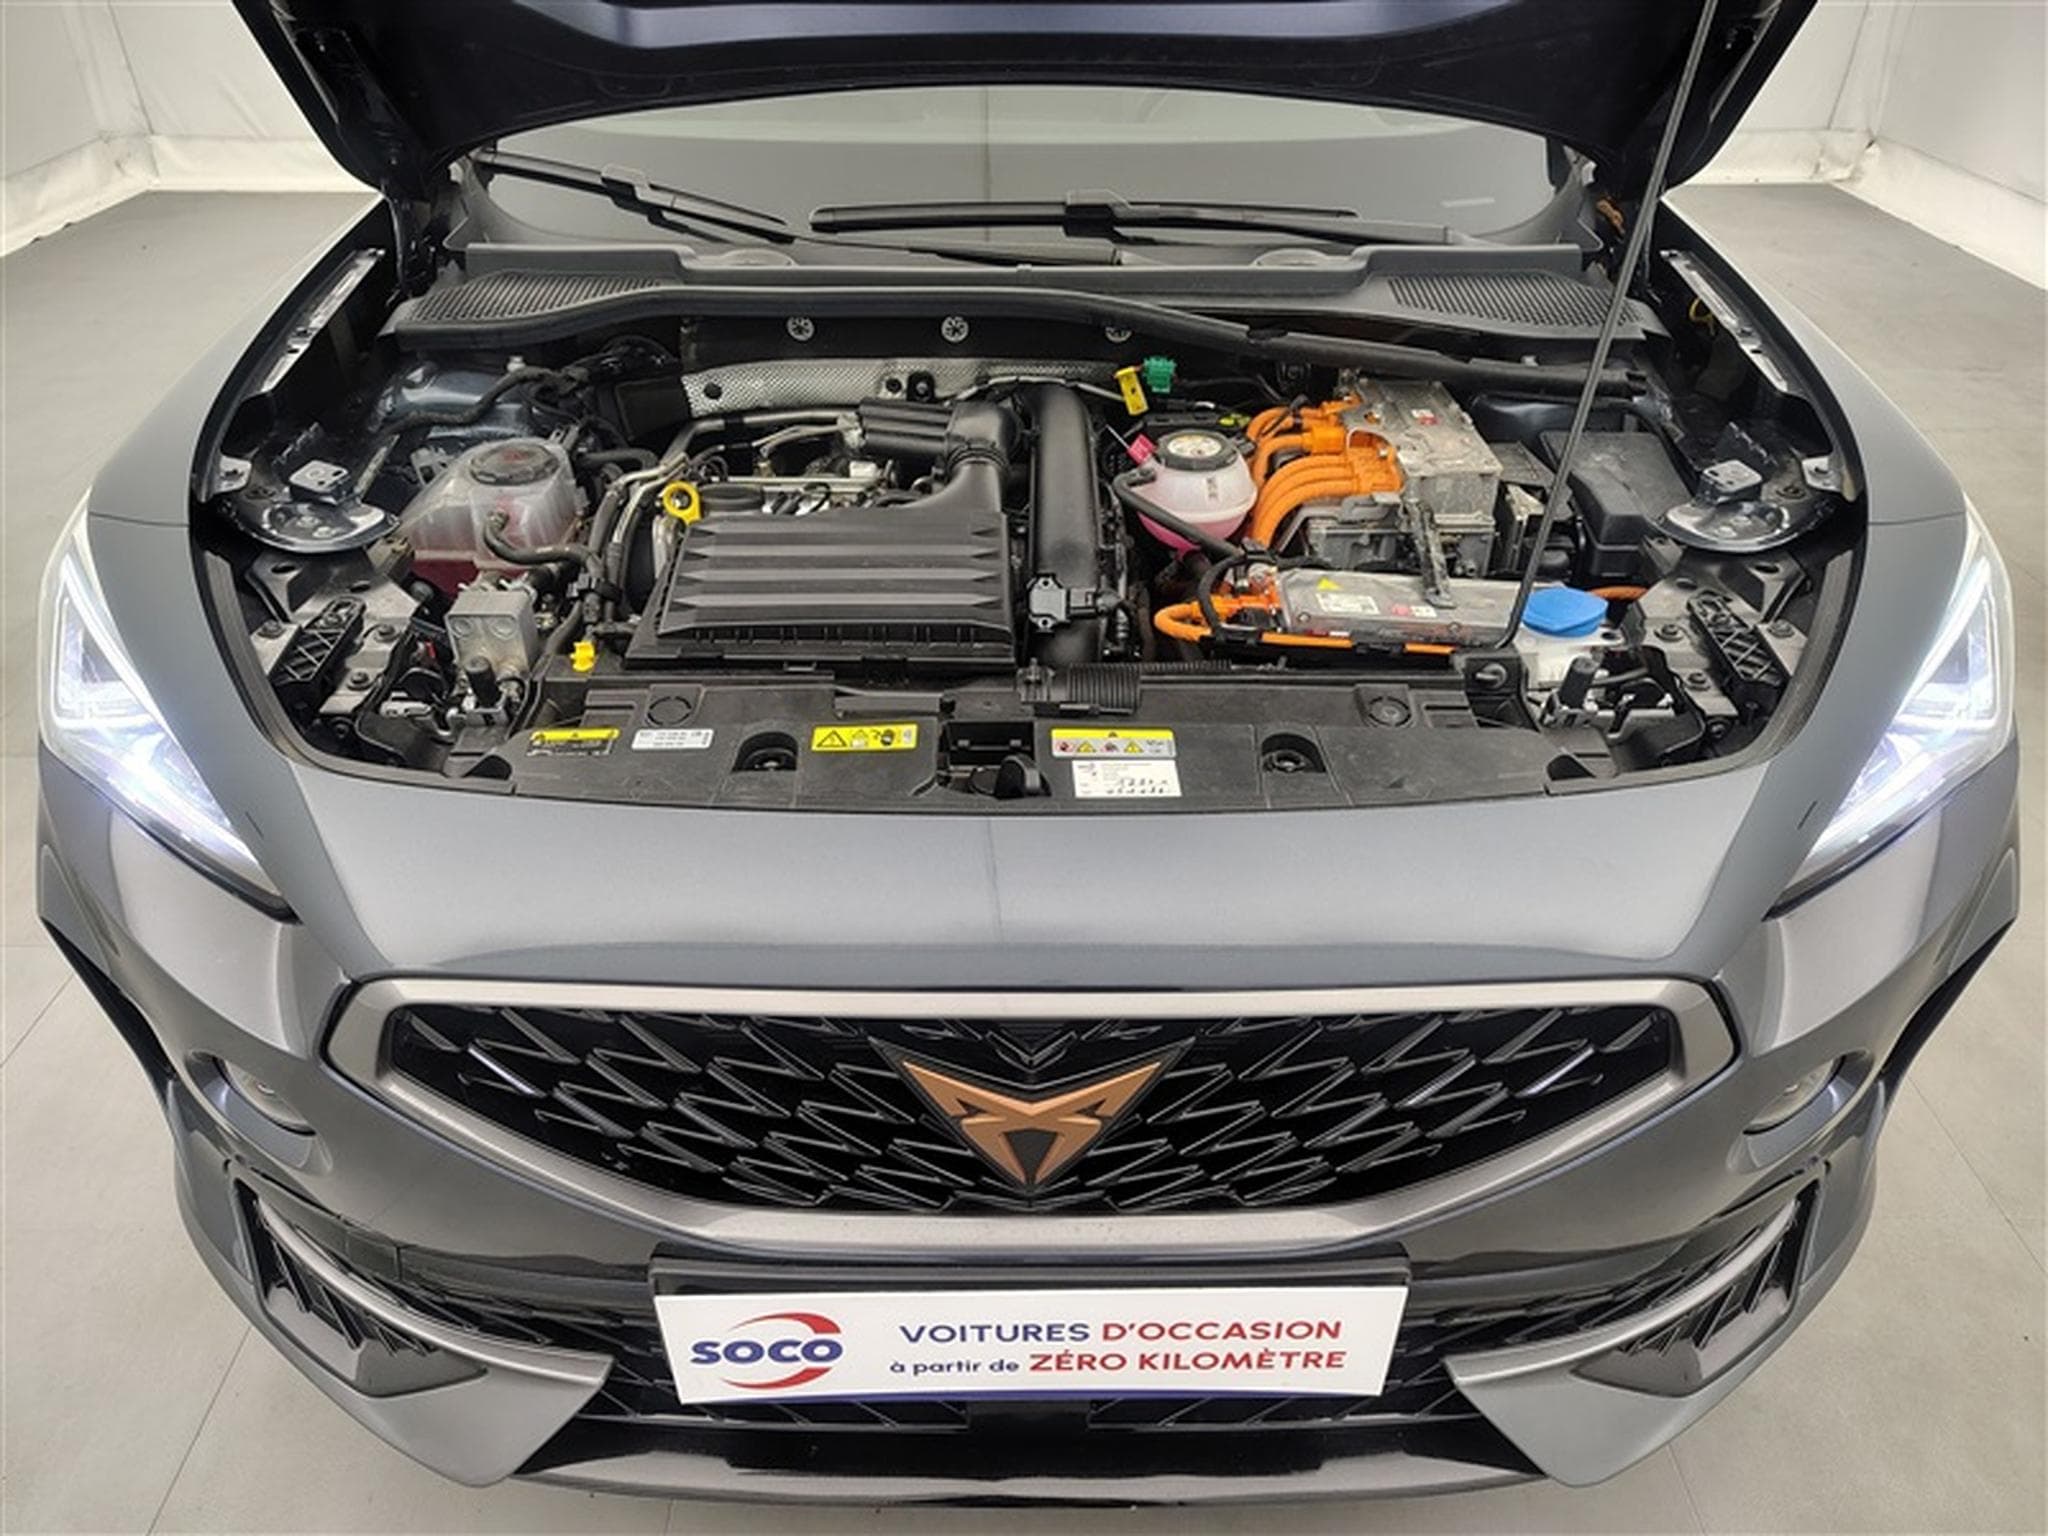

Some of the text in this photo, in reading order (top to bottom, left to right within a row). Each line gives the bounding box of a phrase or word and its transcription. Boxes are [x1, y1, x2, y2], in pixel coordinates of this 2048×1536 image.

[900, 1320, 1342, 1343] VOITURES D'OCCASION
[690, 1339, 843, 1364] SOCO
[890, 1347, 1347, 1377] à partir de ZÉRO KILOMÈTRE
